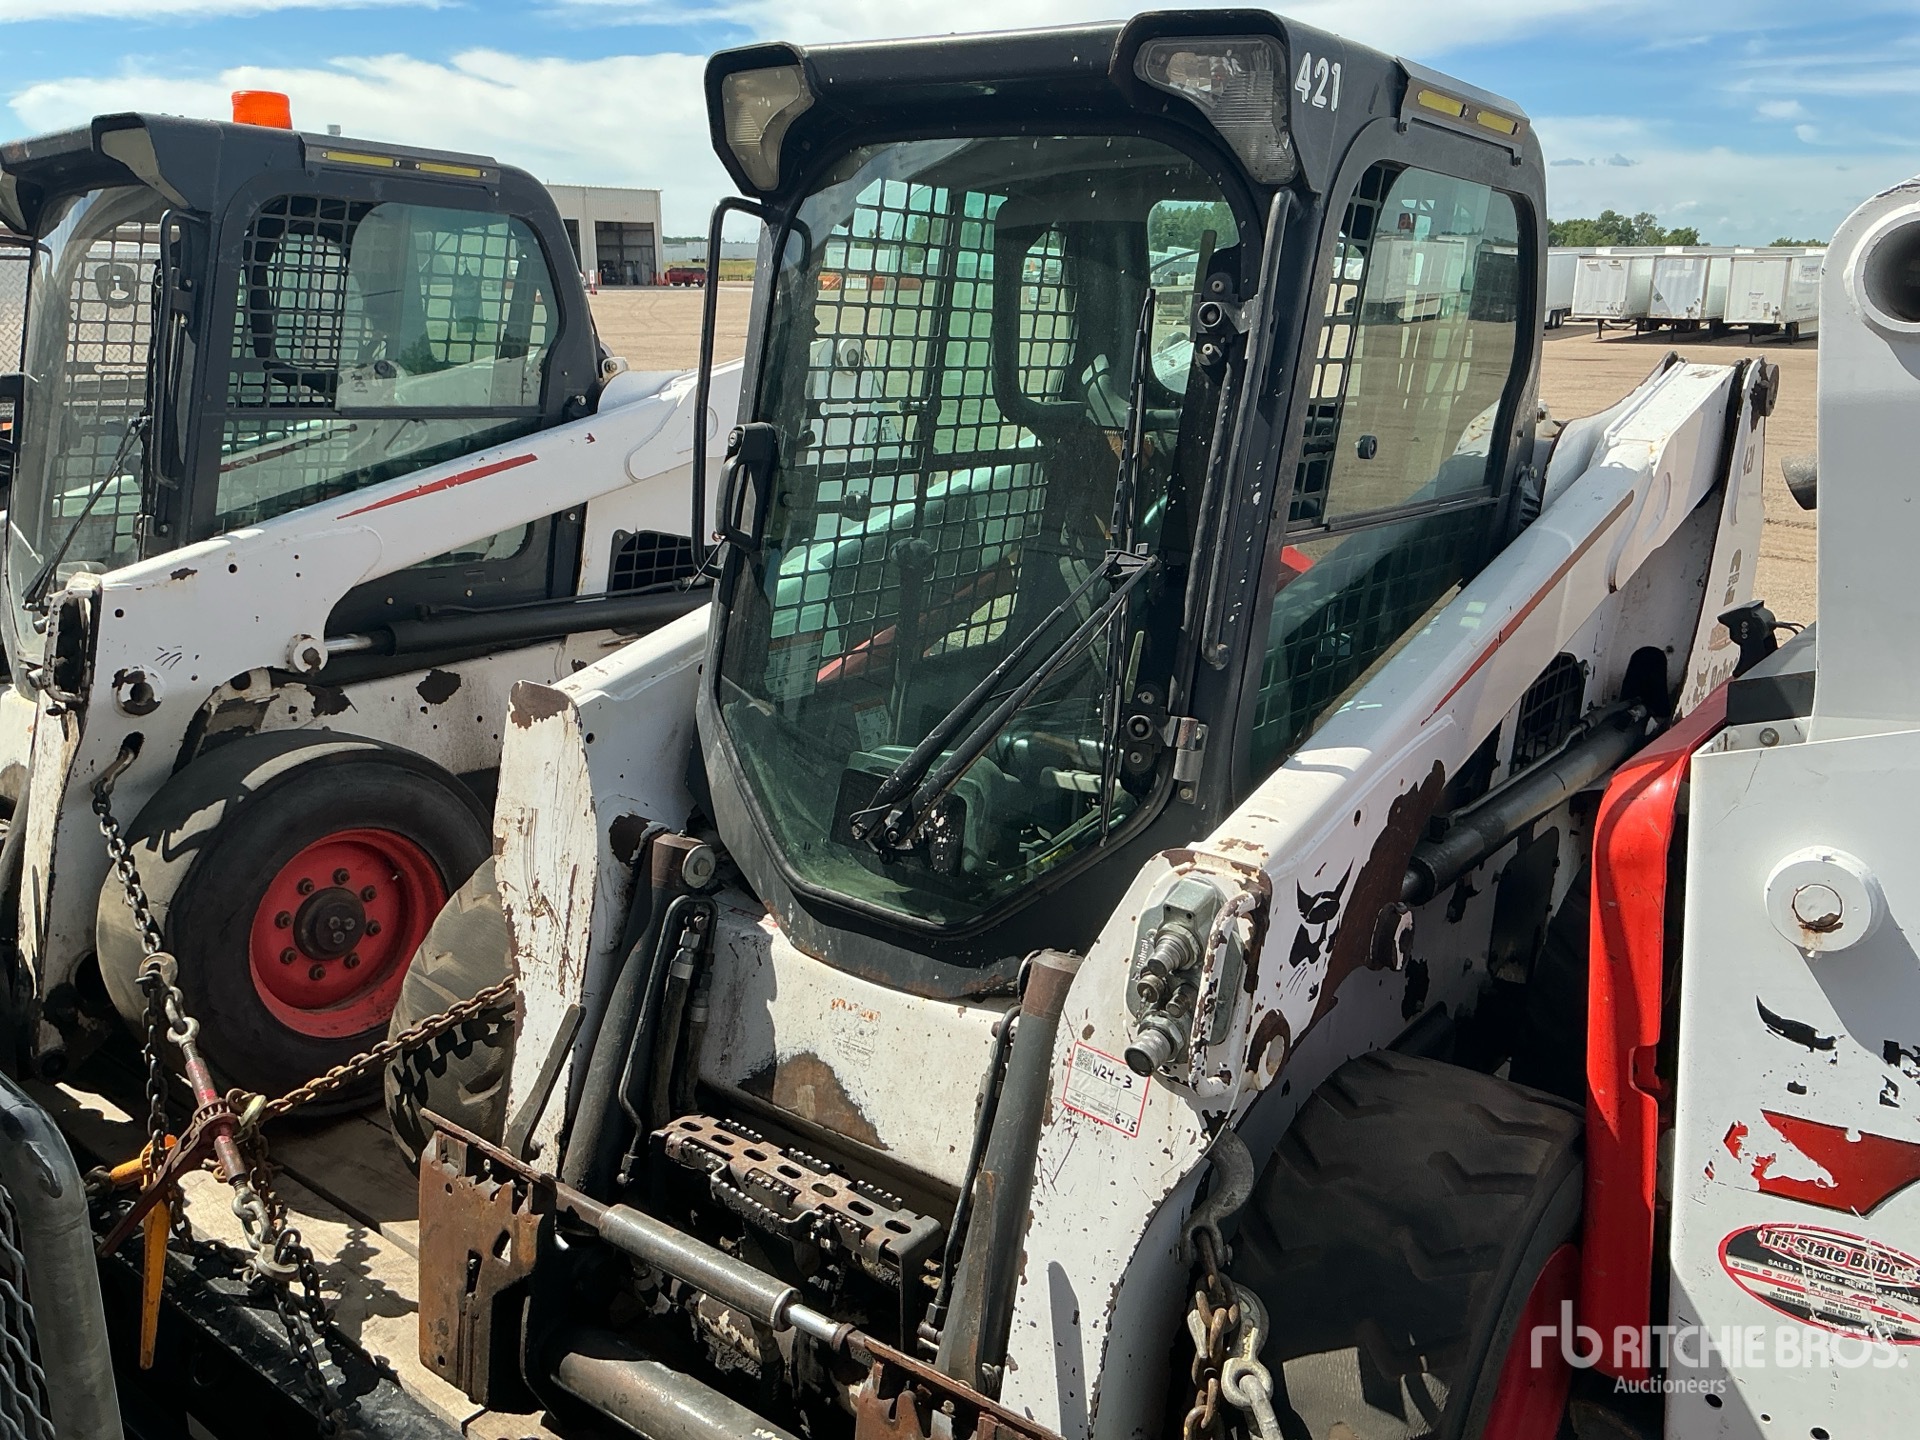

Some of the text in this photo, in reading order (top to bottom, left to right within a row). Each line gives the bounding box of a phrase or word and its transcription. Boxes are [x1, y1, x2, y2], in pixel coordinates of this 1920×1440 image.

[1294, 52, 1341, 111] 421
[1763, 1229, 1920, 1282] Tri-State Bobc
[1775, 1273, 1804, 1285] STIHL
[1768, 1259, 1794, 1271] SALES
[1844, 1280, 1882, 1294] RENTAS
[1890, 1290, 1919, 1303] PARTS
